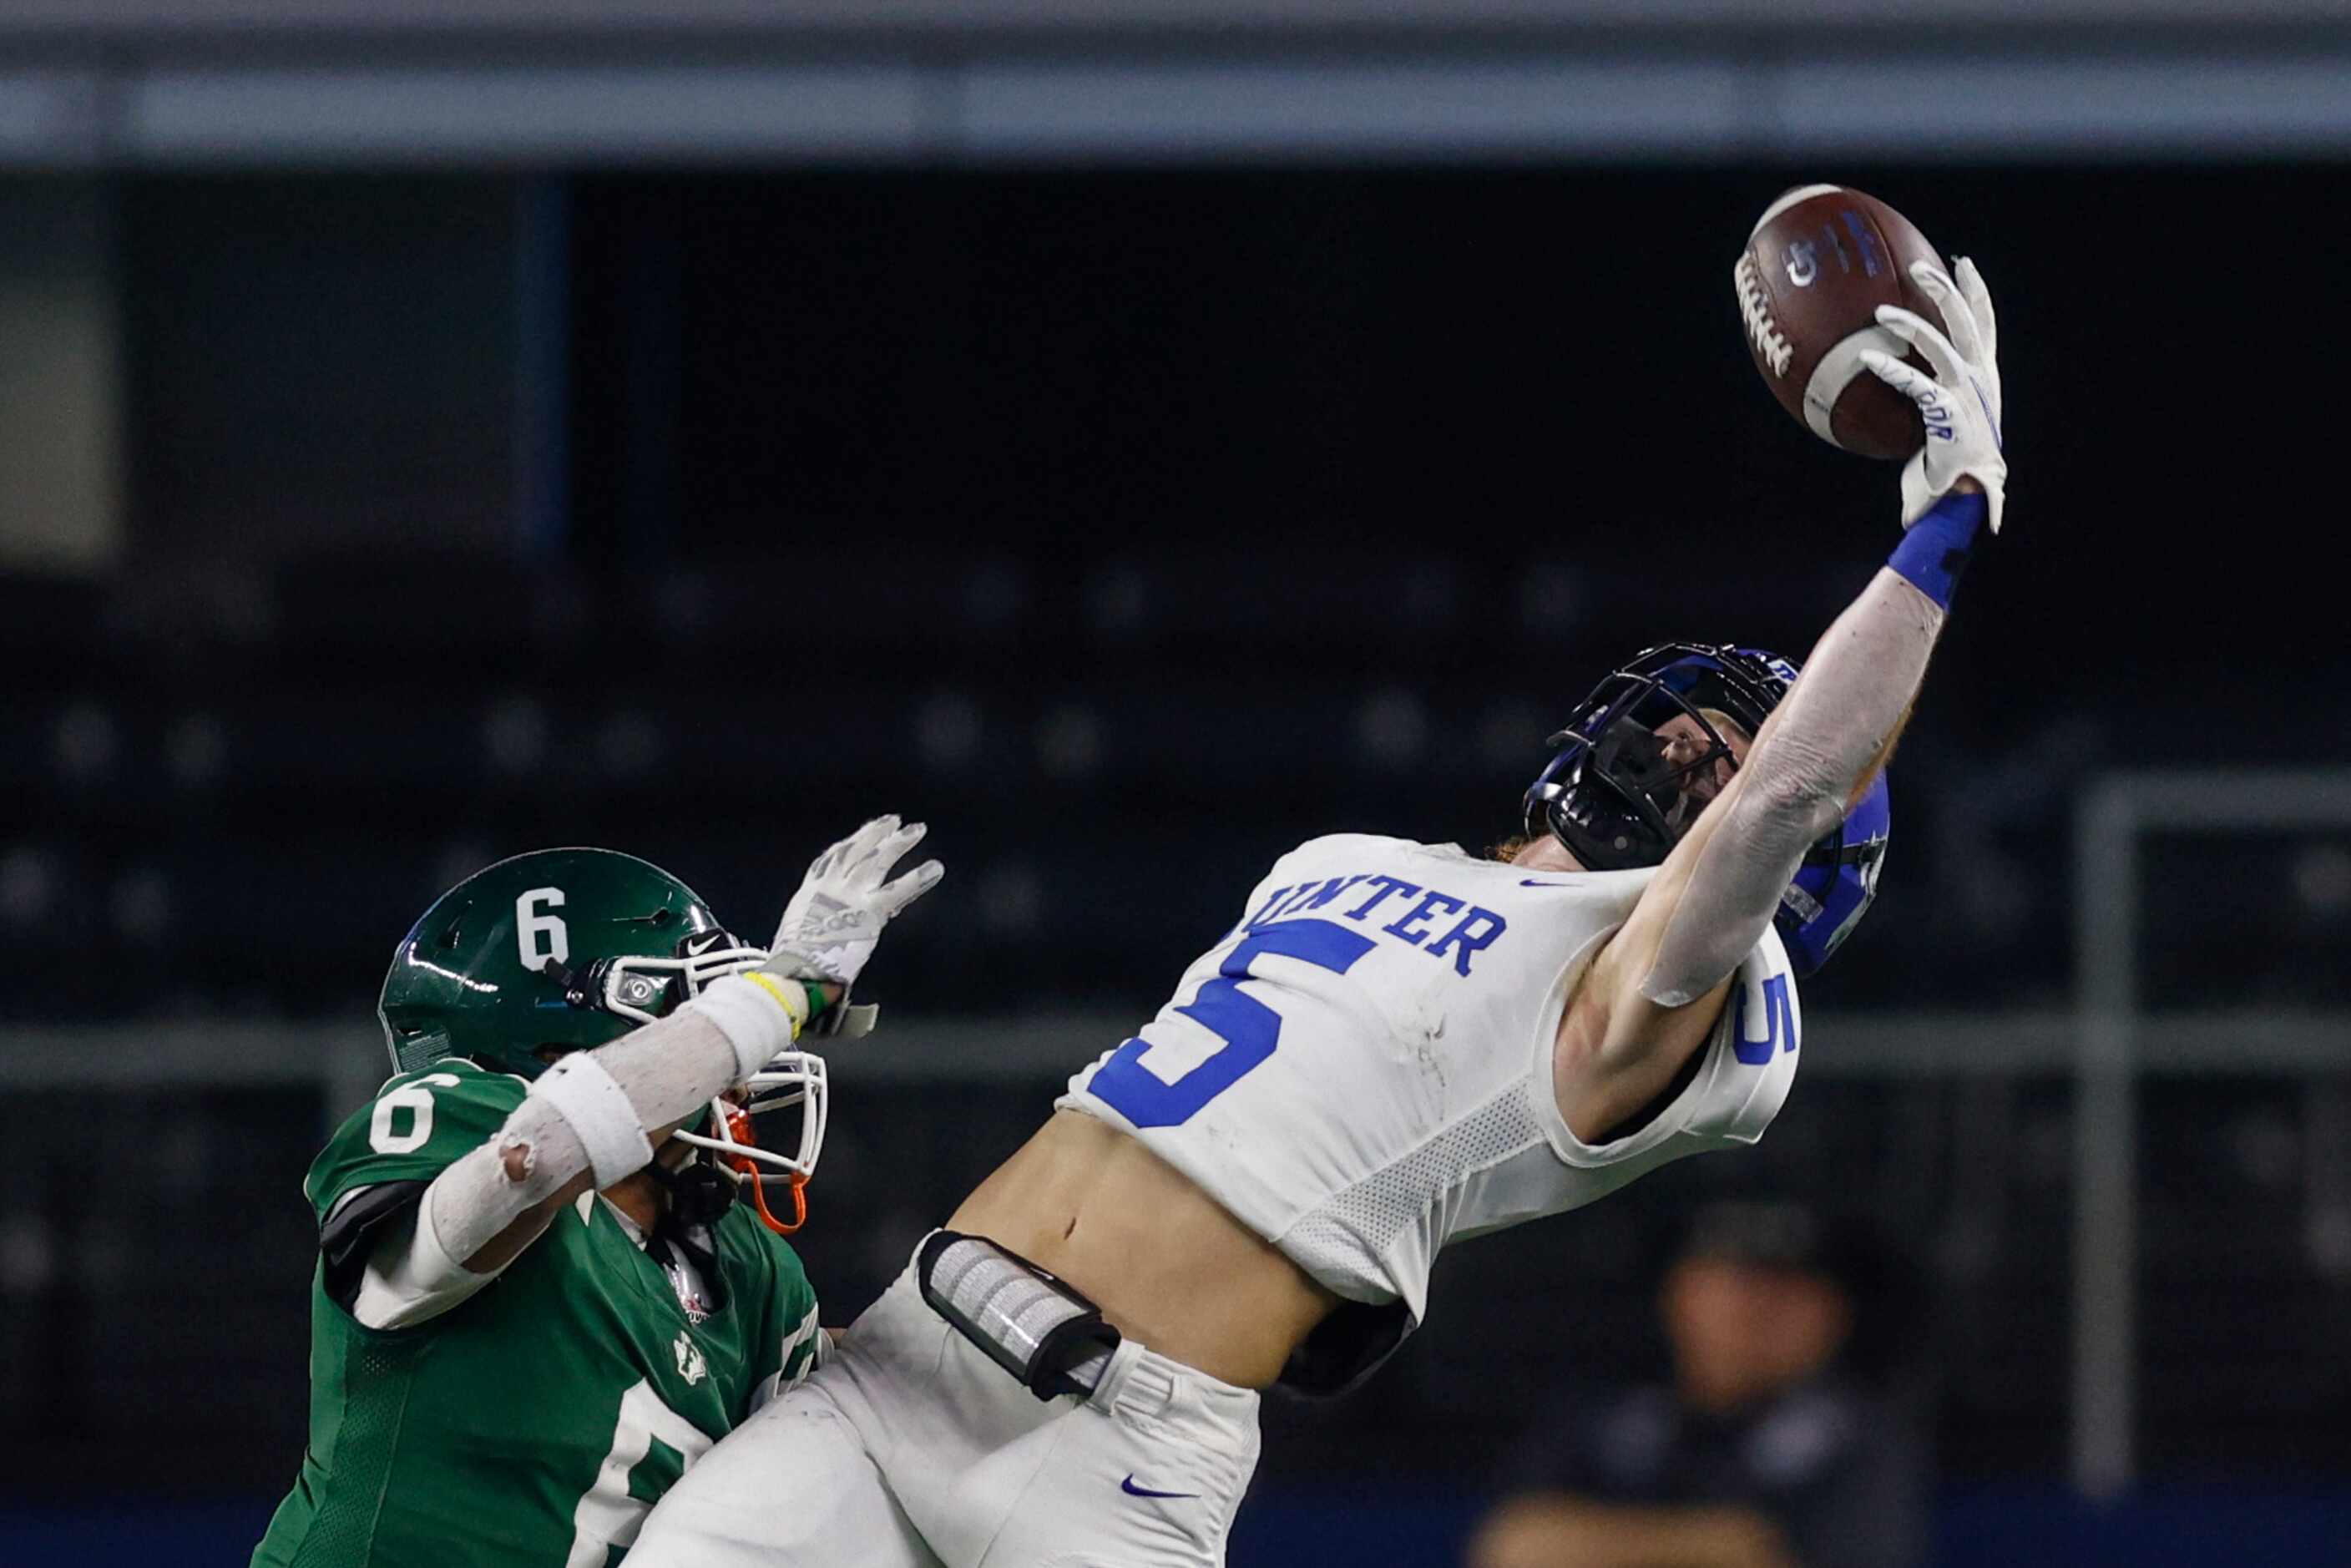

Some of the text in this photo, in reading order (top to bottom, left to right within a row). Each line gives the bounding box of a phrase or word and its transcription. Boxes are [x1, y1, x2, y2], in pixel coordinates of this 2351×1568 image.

[516, 887, 569, 971] 6
[1087, 918, 1378, 1129] 5
[1732, 973, 1796, 1065] 5
[369, 1073, 461, 1154] 6
